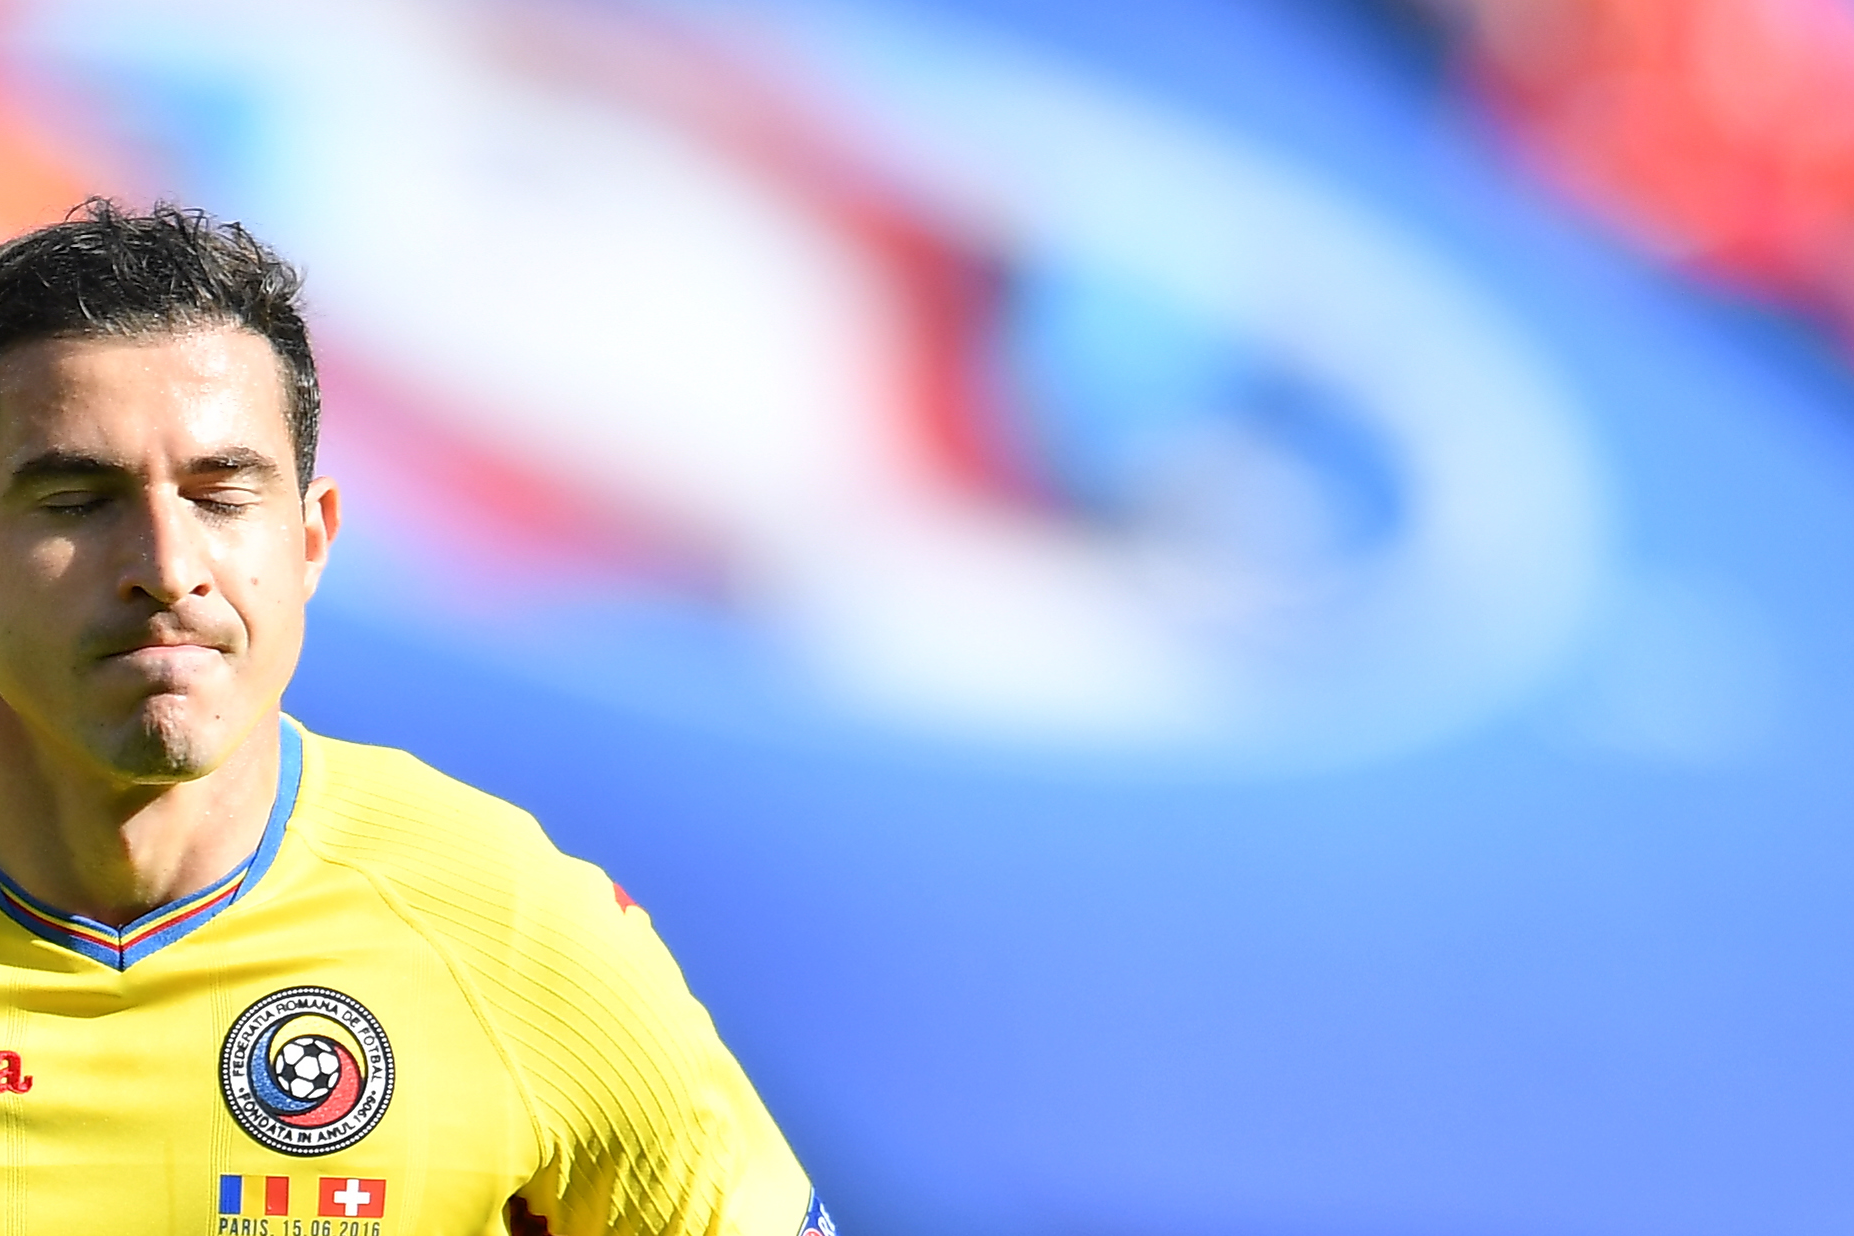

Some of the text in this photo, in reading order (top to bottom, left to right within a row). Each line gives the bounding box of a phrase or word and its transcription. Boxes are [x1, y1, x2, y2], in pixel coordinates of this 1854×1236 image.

[276, 998, 338, 1015] ROMANA
[342, 1010, 361, 1028] DE
[357, 1027, 383, 1082] FOTBAL
[297, 1132, 312, 1143] IN
[353, 1095, 377, 1123] 1909
